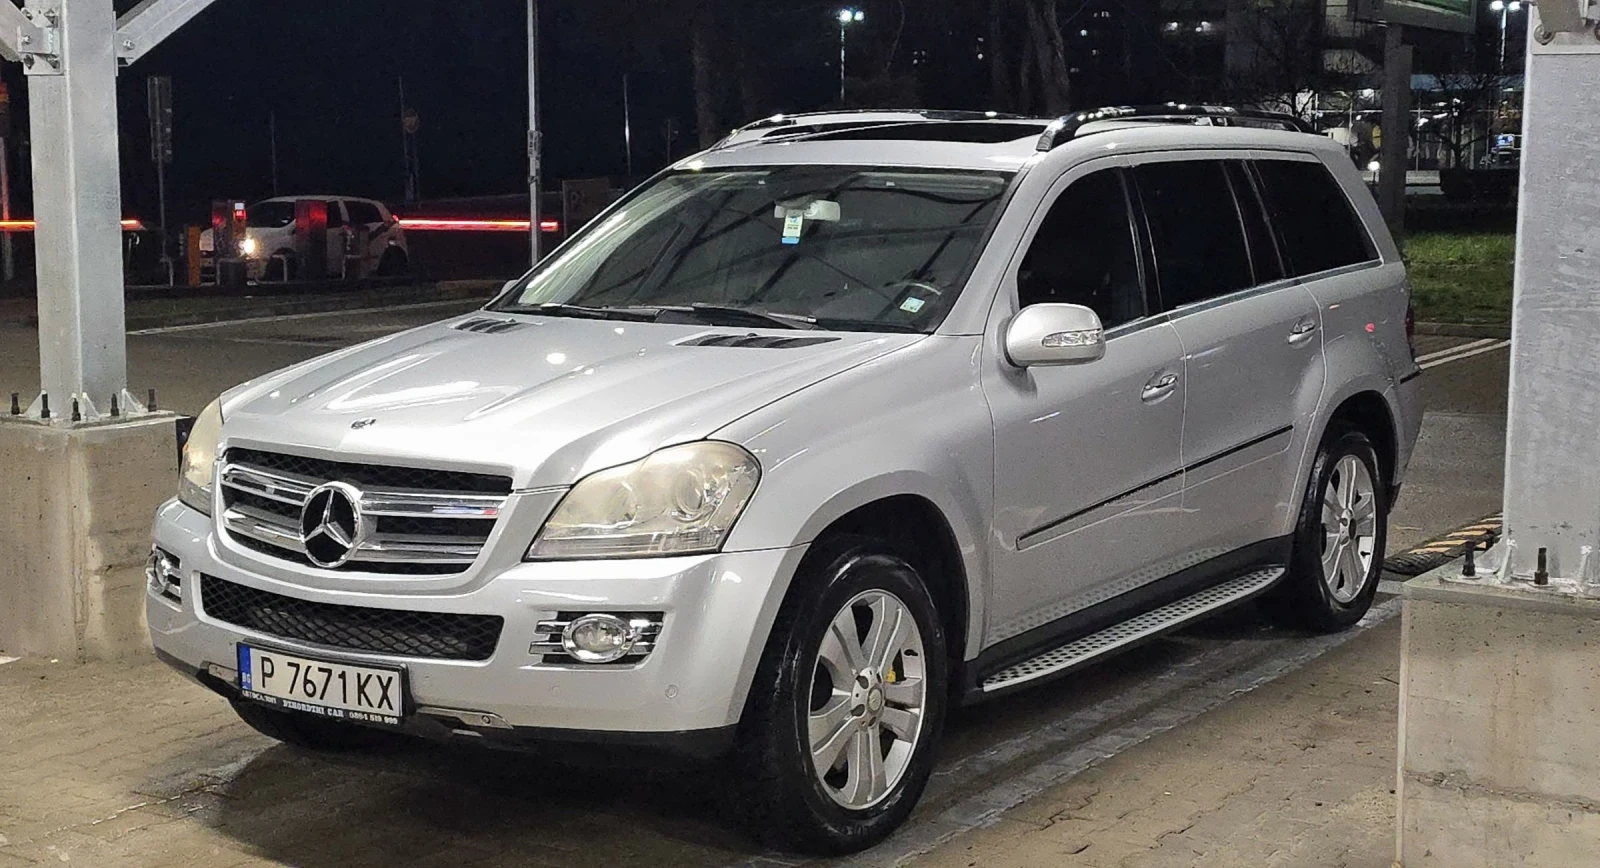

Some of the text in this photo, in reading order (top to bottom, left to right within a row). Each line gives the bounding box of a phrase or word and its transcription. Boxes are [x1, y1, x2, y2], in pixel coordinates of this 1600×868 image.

[242, 671, 251, 684] BG
[261, 656, 275, 688] P
[327, 708, 344, 718] CAR
